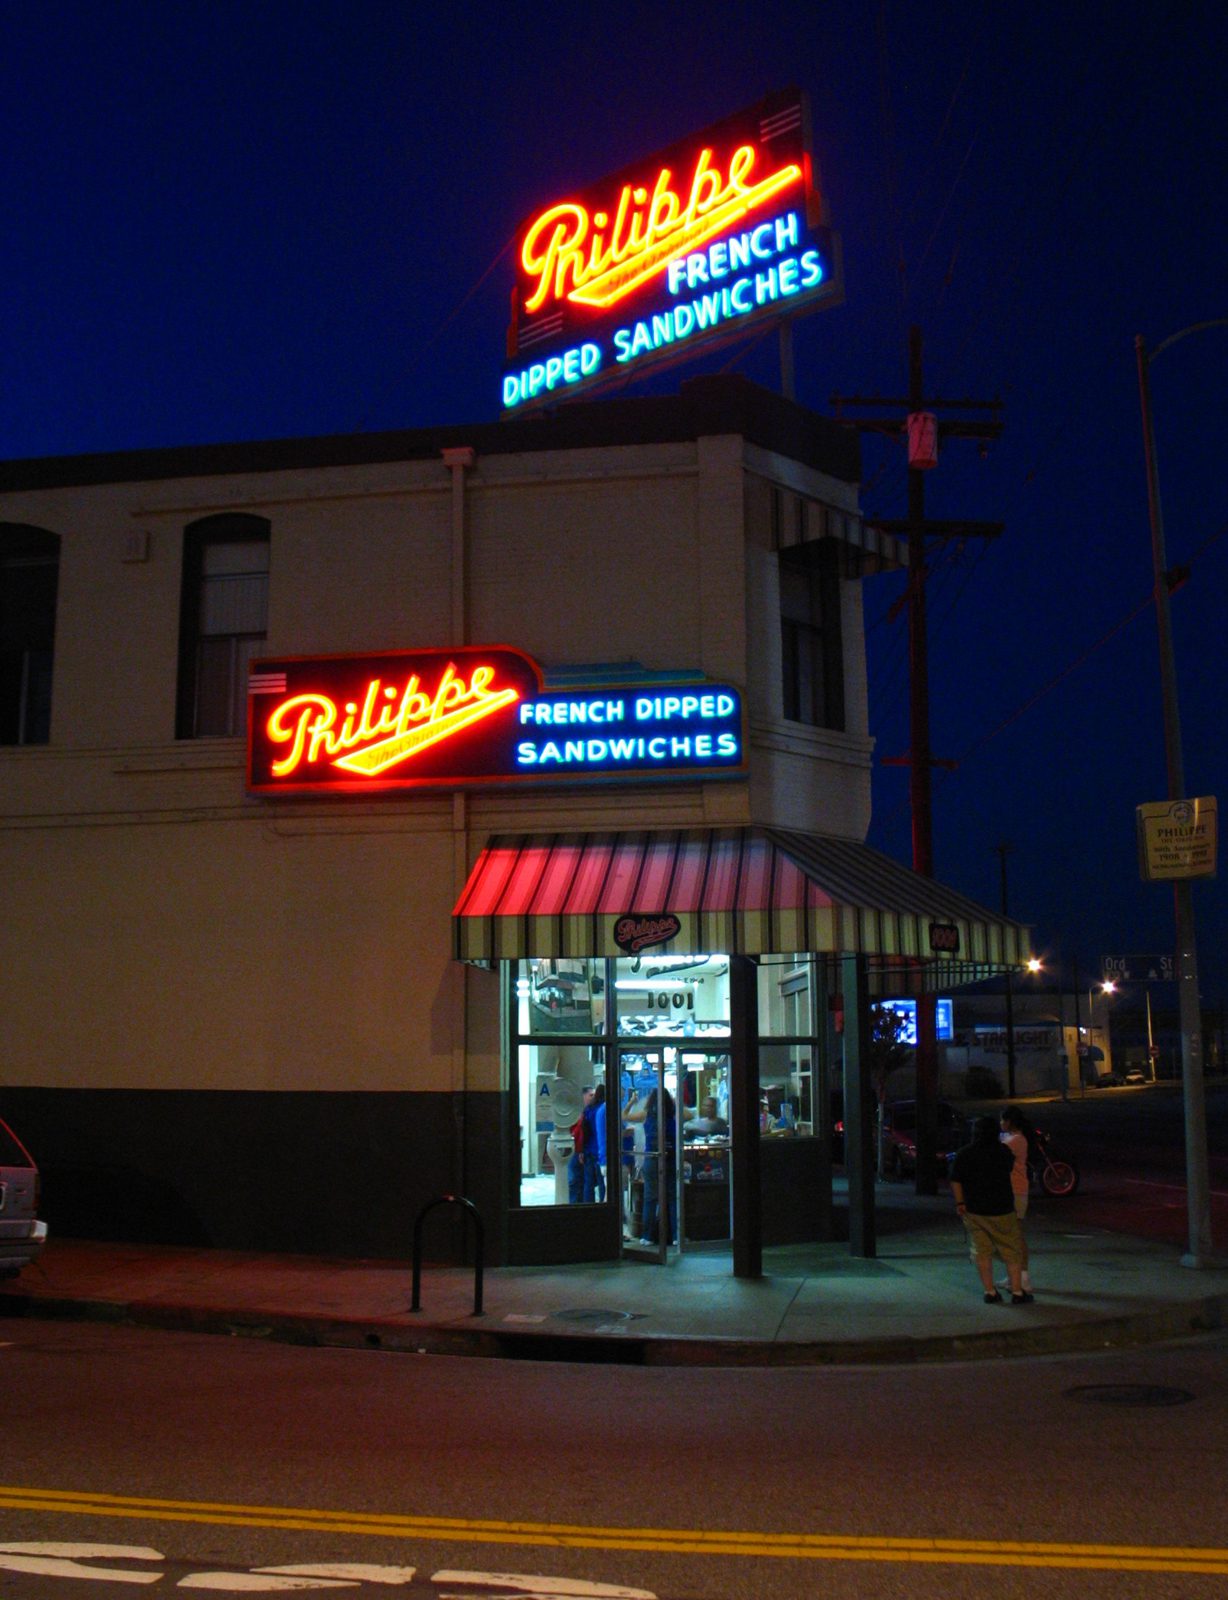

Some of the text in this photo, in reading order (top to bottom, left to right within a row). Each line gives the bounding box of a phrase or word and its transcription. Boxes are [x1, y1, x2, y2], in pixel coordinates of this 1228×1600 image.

[522, 146, 772, 313] Philippe
[667, 212, 799, 295] FRENCH
[502, 342, 602, 408] DIPPED
[613, 249, 824, 363] SANDWICHES
[266, 662, 502, 778] Philippe
[519, 693, 735, 726] FRENCH DIPPED
[517, 735, 737, 764] SANDWICHES
[1104, 957, 1173, 970] Ord St
[647, 992, 694, 1010] 1001
[540, 1083, 550, 1096] A
